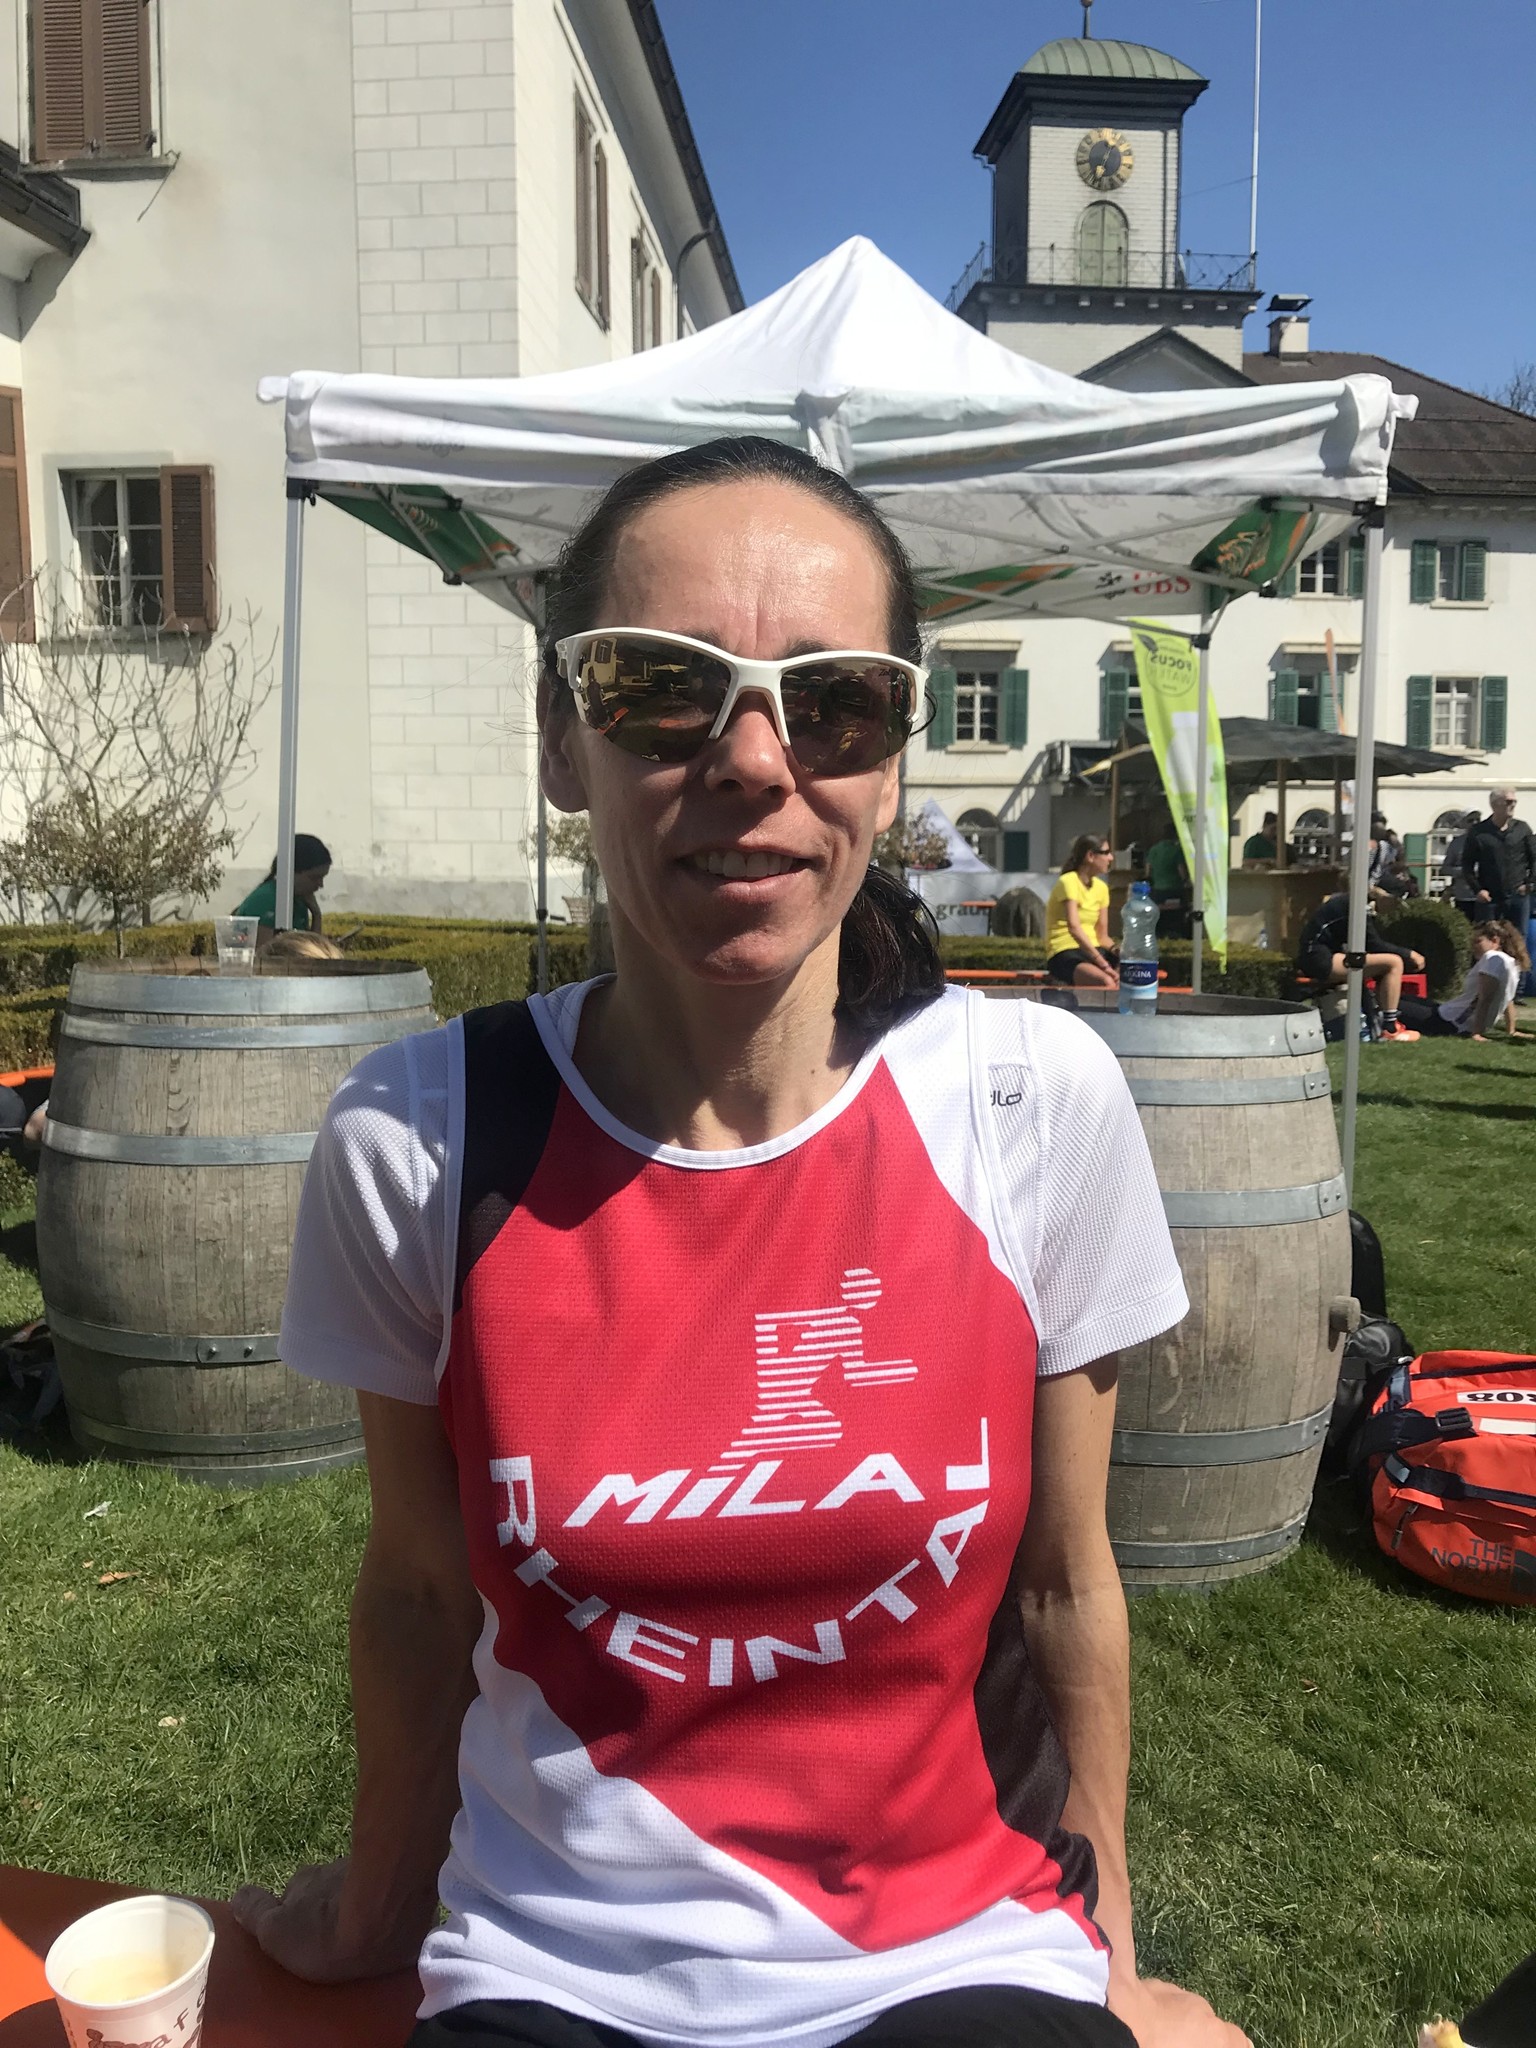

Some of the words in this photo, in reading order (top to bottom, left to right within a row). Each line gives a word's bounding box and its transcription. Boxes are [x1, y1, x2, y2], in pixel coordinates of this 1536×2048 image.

[489, 1416, 991, 1687] RHEINTAL
[1431, 1547, 1512, 1577] NORTH
[1469, 1538, 1512, 1563] THE
